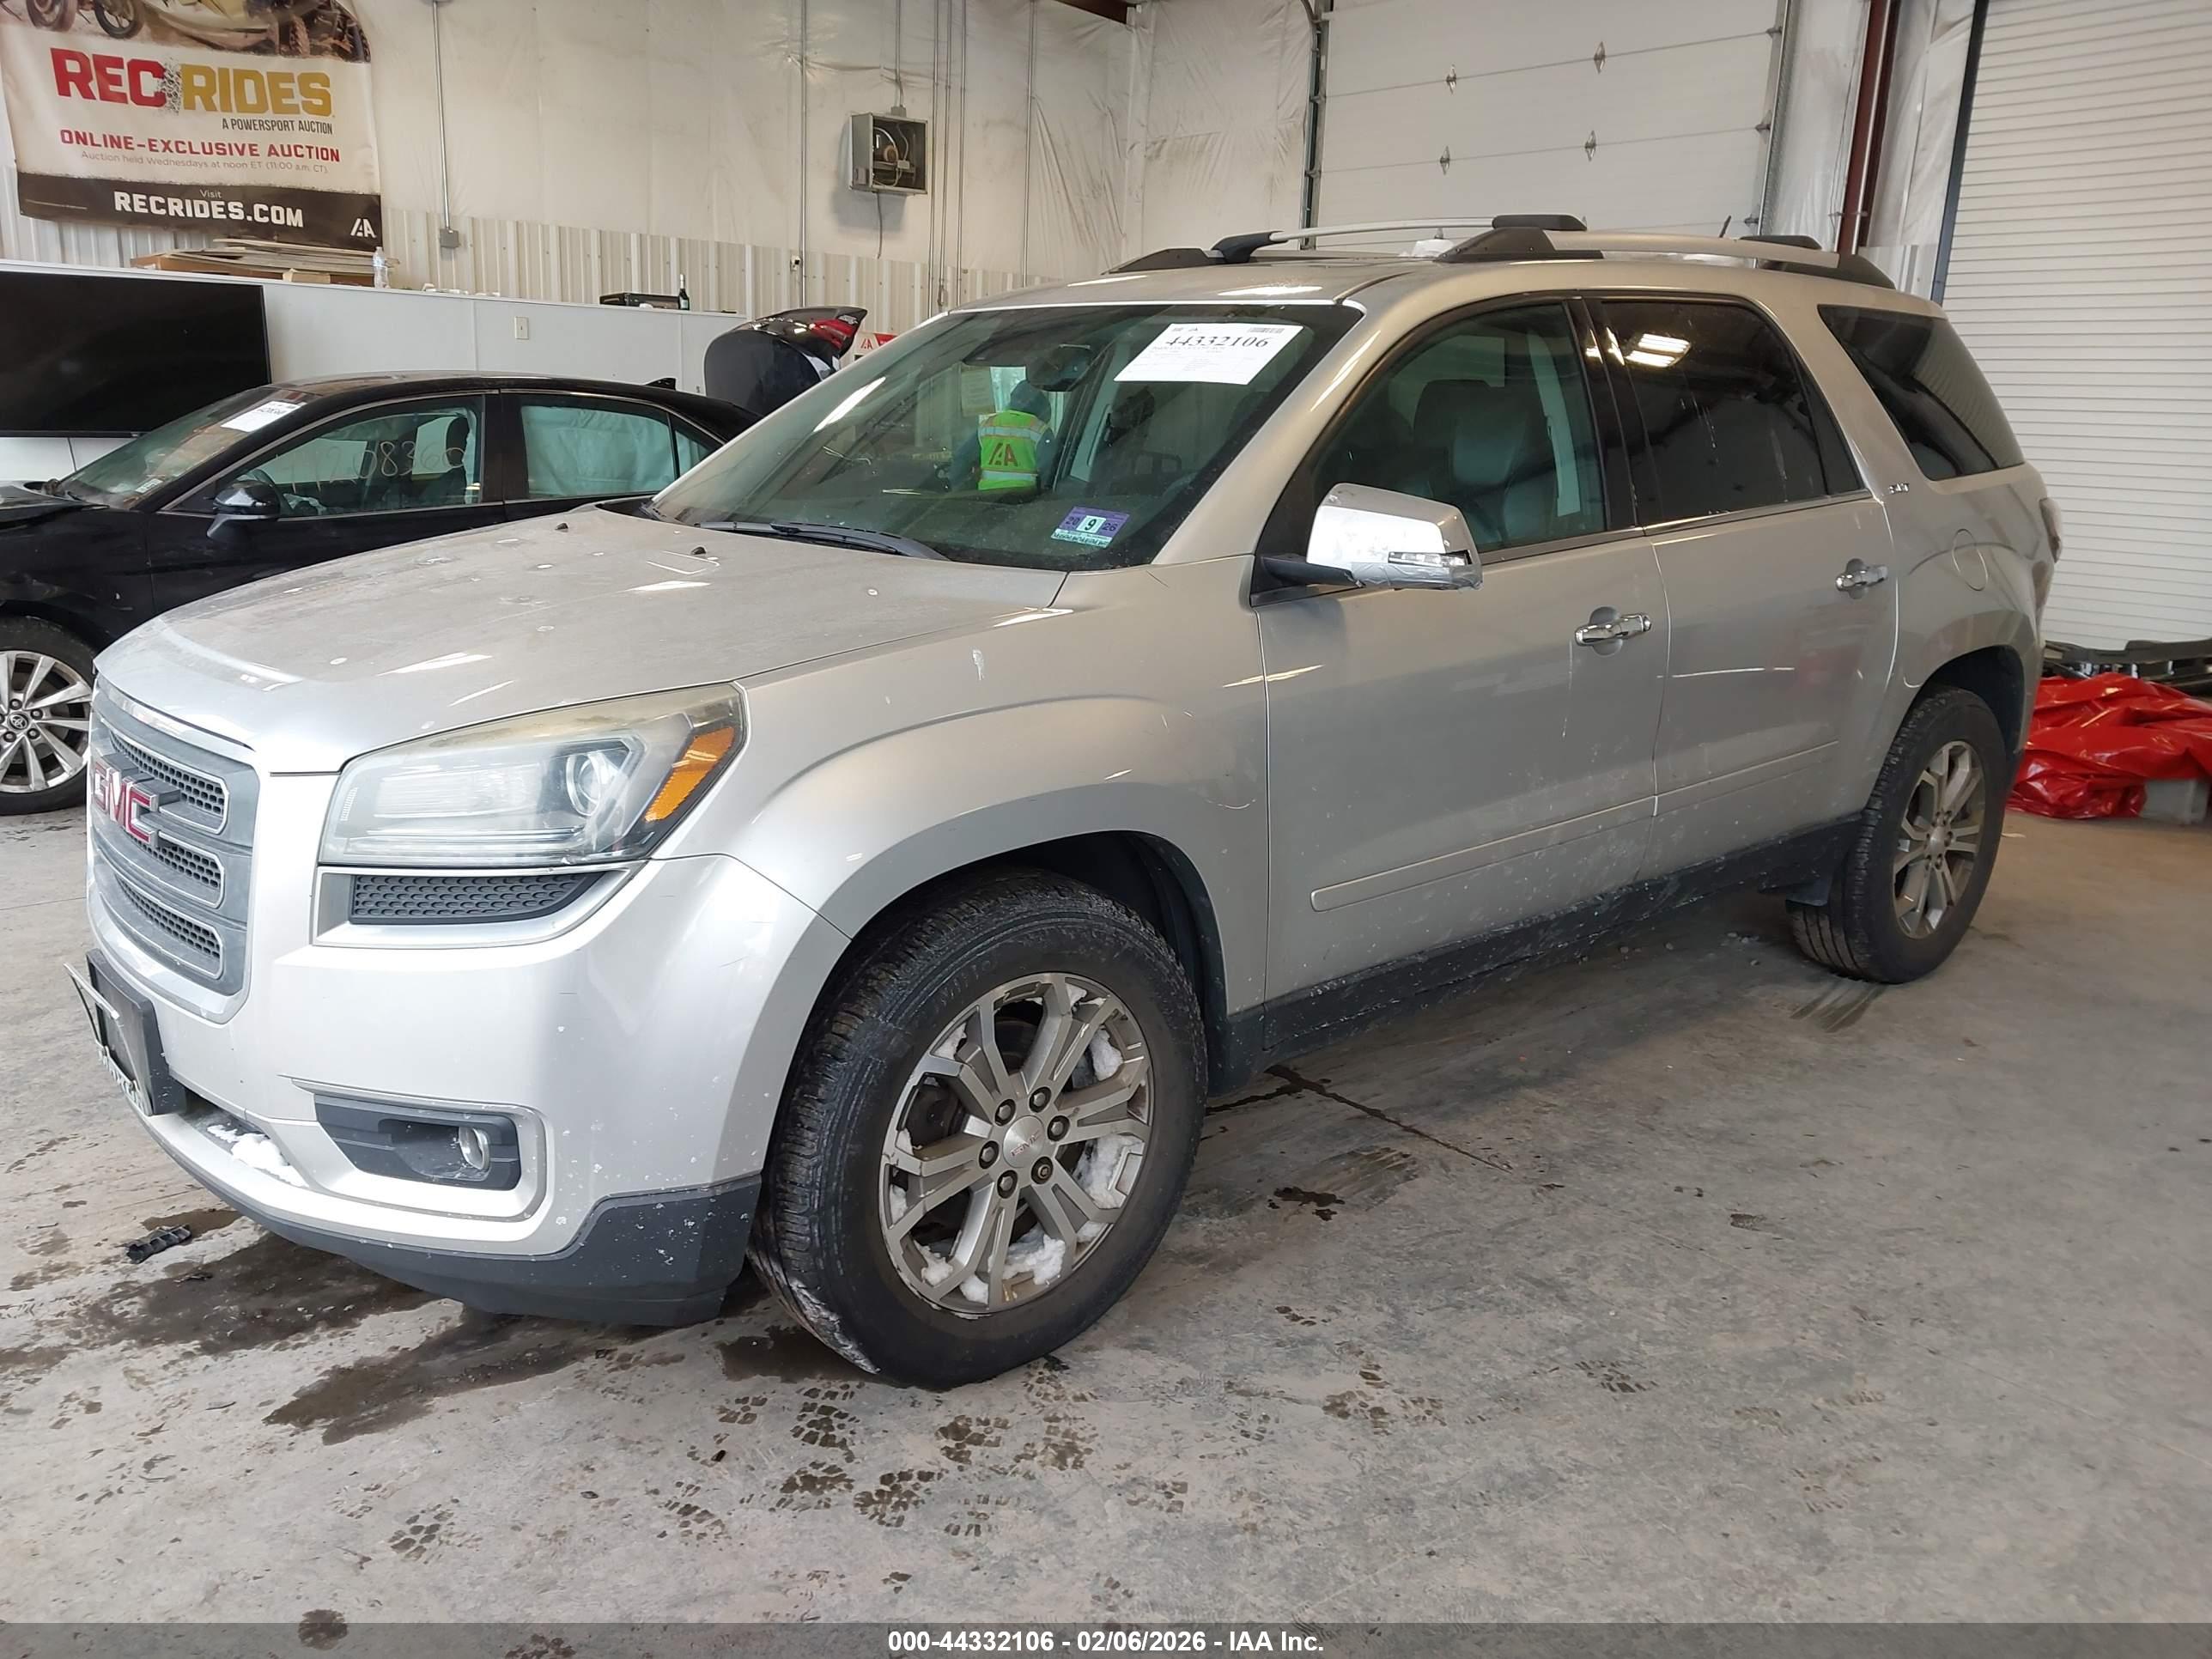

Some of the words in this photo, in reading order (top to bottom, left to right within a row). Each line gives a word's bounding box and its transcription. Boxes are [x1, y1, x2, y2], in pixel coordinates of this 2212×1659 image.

[50, 47, 167, 108] REC
[180, 64, 334, 118] RIDES
[222, 118, 229, 131] A
[231, 118, 295, 133] POWERSPORT
[298, 120, 333, 135] AUCTION
[60, 129, 260, 158] ONLINE-EXCLUSIVE
[267, 143, 340, 163] AUCTION
[82, 150, 120, 163] Auction
[123, 154, 143, 165] held
[147, 156, 209, 169] Wednesdays
[211, 160, 221, 169] at
[225, 161, 248, 170] noon
[251, 161, 263, 170] ET
[200, 188, 222, 199] Visit
[114, 191, 304, 228] RECRIDES.COM
[1165, 336, 1271, 348] 44332106
[1085, 519, 1097, 531] 9
[94, 761, 156, 844] GMC
